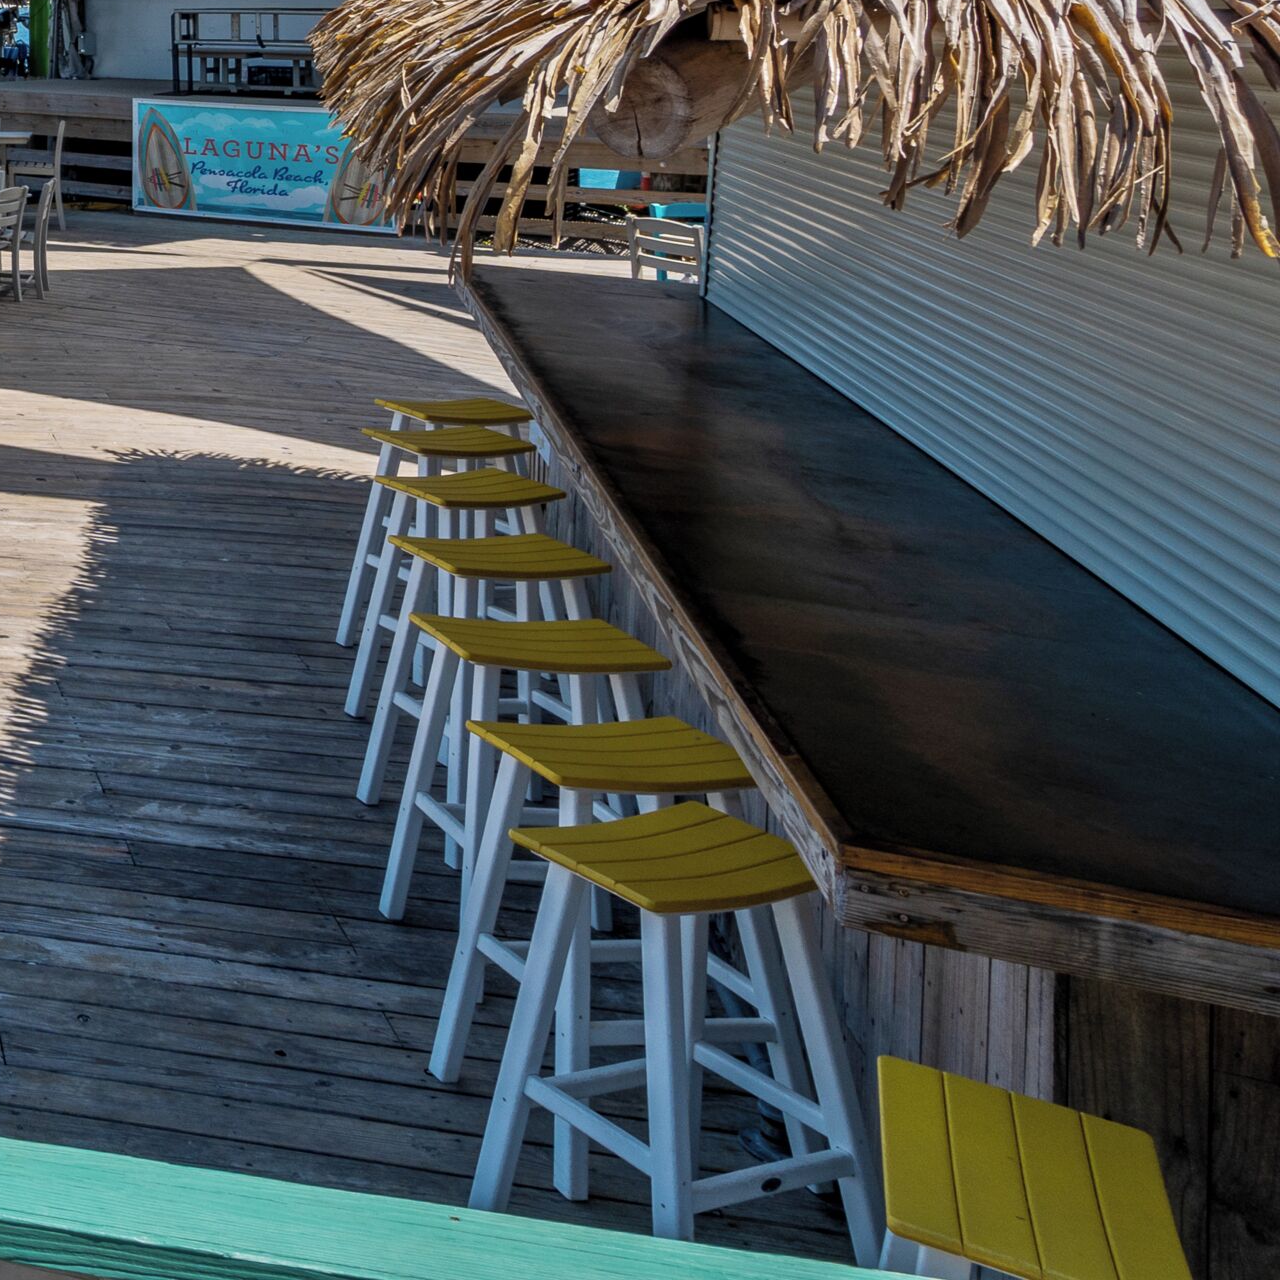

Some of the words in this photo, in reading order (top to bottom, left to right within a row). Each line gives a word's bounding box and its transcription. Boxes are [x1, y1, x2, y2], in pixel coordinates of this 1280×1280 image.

[191, 160, 268, 180] Pensacola
[273, 166, 329, 186] Beach,
[226, 179, 289, 197] Florida
